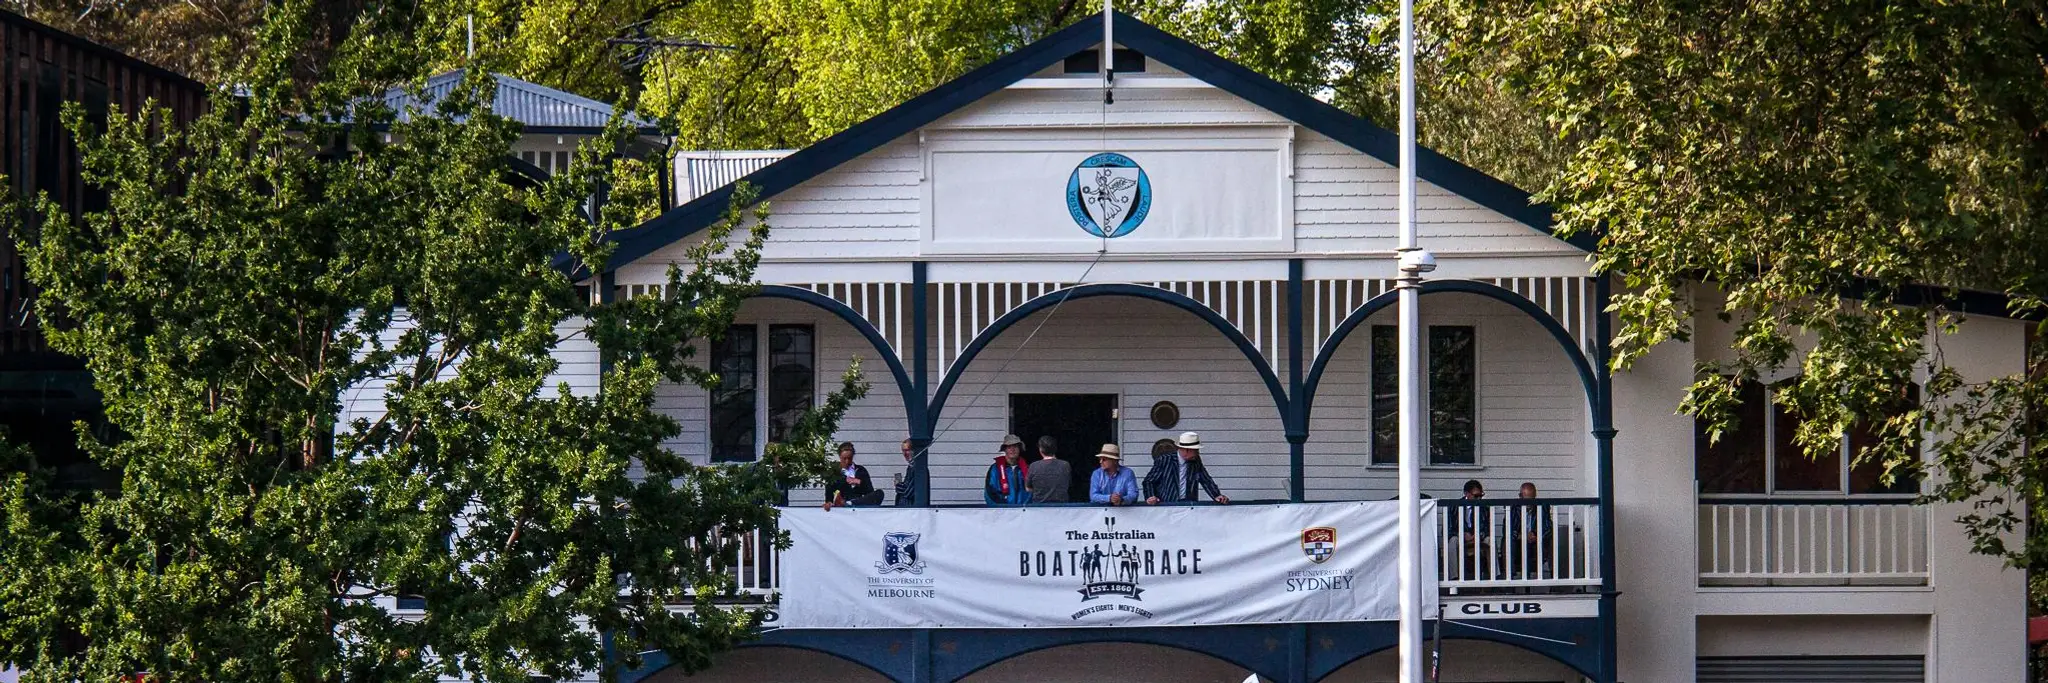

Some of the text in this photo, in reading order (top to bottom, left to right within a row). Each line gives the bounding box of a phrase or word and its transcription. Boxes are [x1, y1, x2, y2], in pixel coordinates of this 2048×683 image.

[1133, 195, 1148, 223] LAUDE
[1065, 529, 1155, 540] The Australian
[1019, 548, 1202, 577] BOAT RACE
[1302, 569, 1343, 577] UNIVERSITY
[1345, 567, 1355, 575] OF
[1090, 584, 1132, 593] EST. 1860
[1286, 576, 1353, 592] SYDNEY
[867, 589, 935, 599] MELBOURNE
[1071, 604, 1154, 621] WOMEN'S EIGHTS MEN'S EIGHTS
[1461, 602, 1542, 615] CLUB
